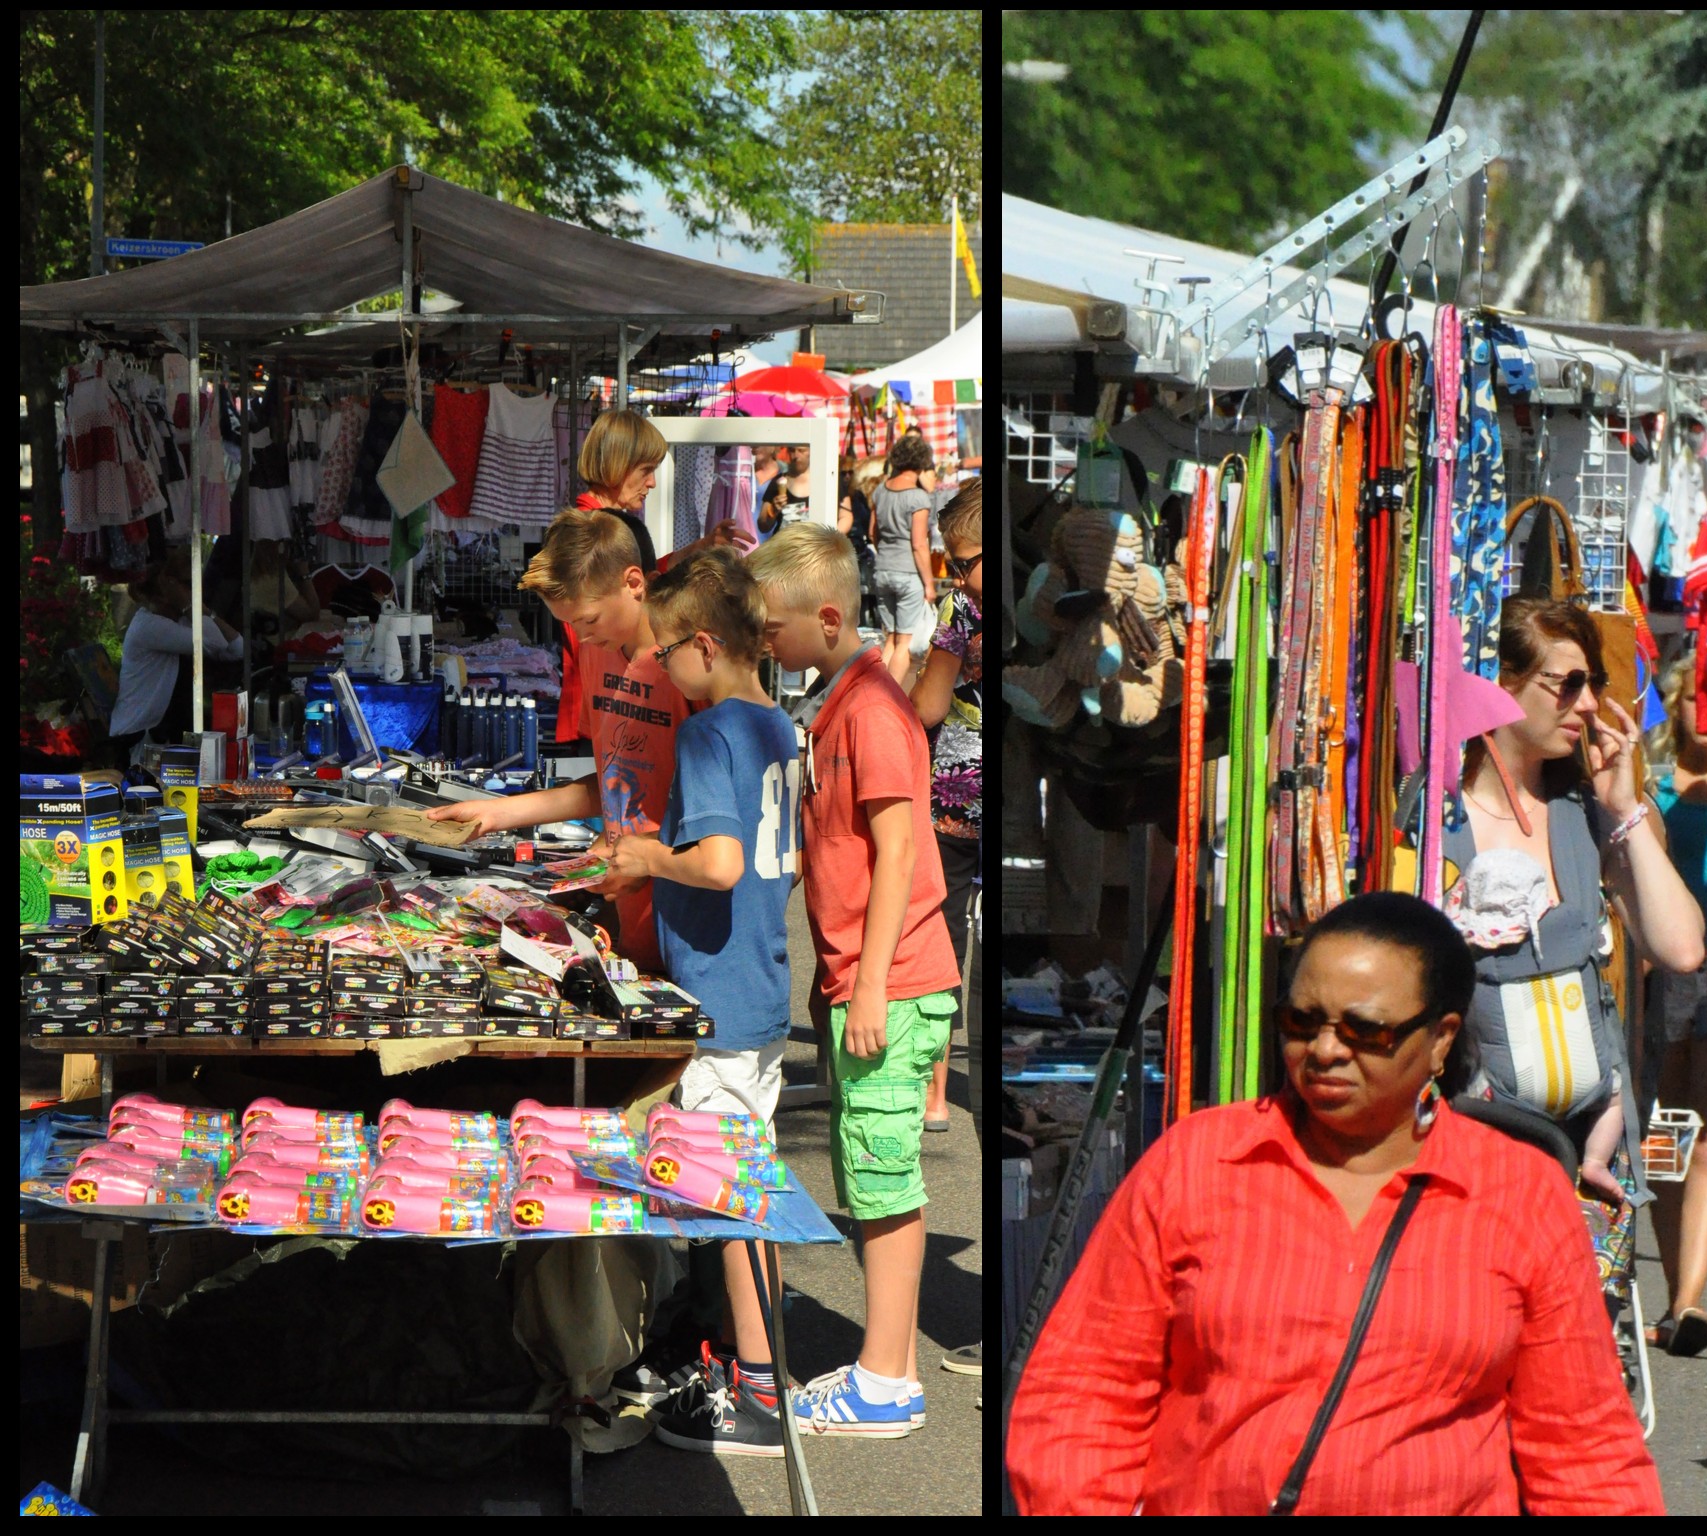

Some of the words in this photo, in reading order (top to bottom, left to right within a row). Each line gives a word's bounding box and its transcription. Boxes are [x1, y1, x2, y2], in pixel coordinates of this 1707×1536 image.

[112, 242, 180, 254] Keizerskroon
[603, 672, 653, 699] GREAT
[592, 695, 672, 727] MEMORIES
[38, 803, 81, 812] 15m/50ft
[22, 827, 47, 838] HOSE
[107, 830, 121, 838] HOSE
[57, 840, 78, 854] 3X
